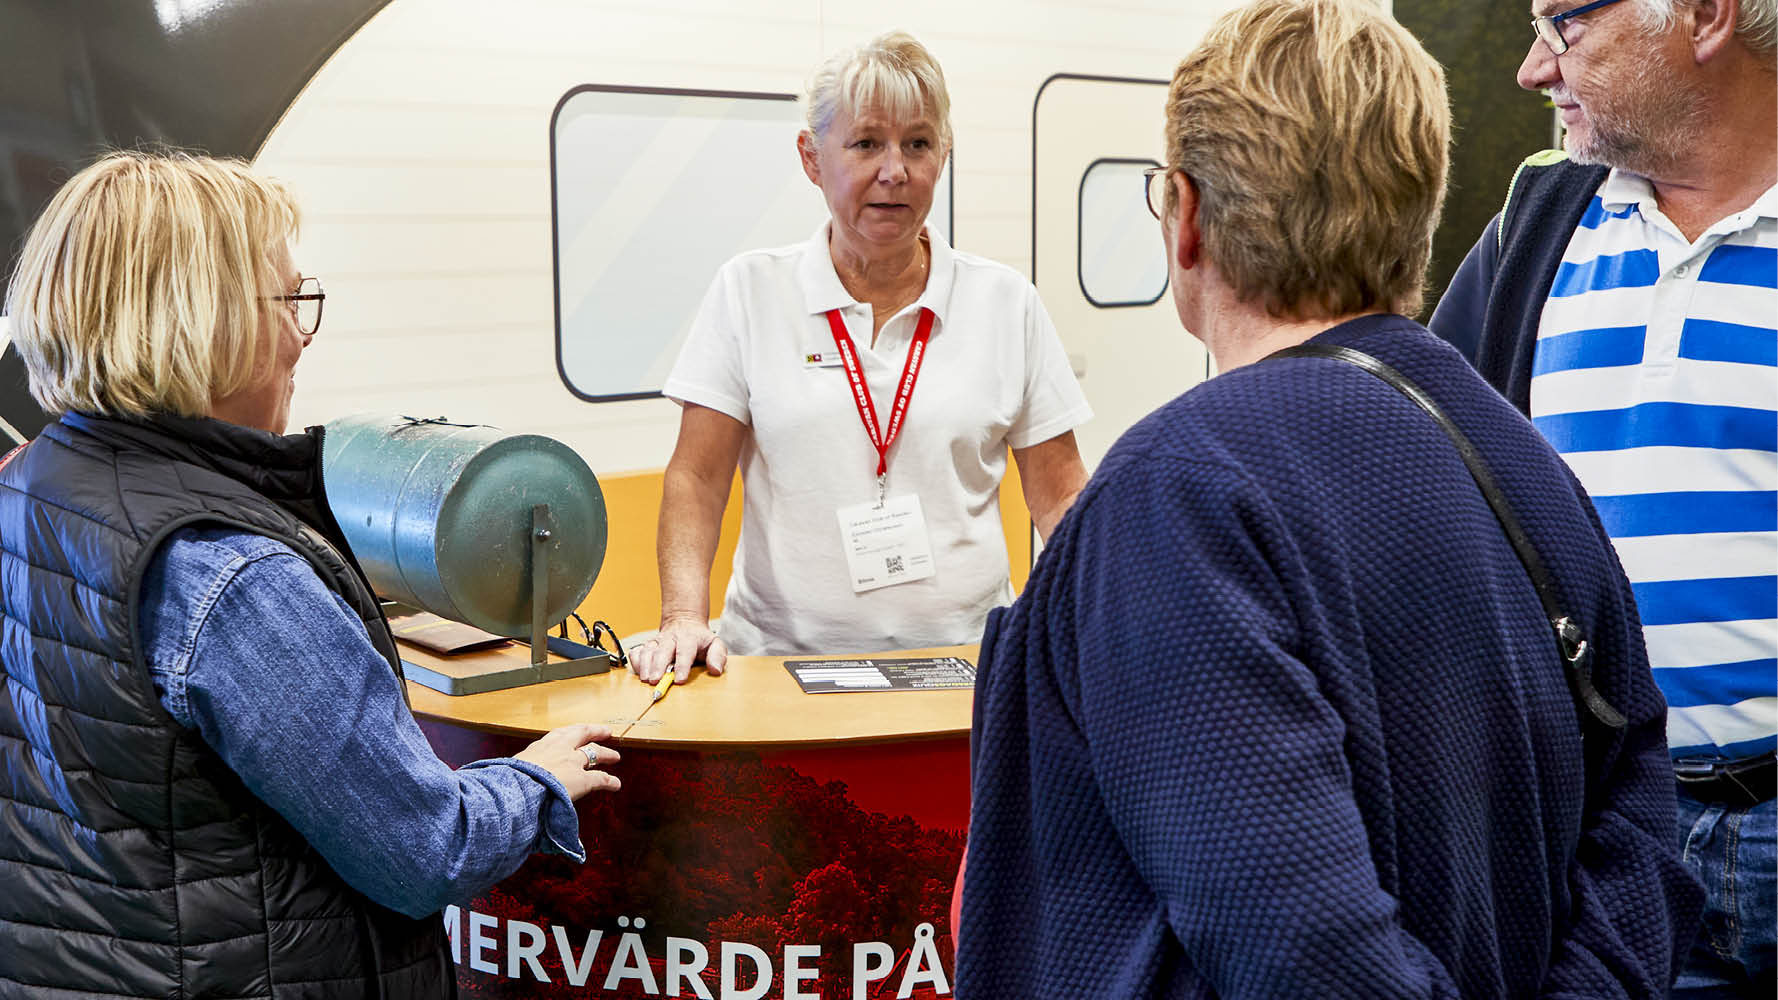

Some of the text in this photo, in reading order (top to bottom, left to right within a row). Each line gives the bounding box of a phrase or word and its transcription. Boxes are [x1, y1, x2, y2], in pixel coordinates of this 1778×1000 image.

[909, 340, 923, 375] CARAVAN
[850, 371, 860, 383] OF
[901, 373, 914, 397] CLUB
[855, 383, 868, 408] CLUB
[897, 396, 906, 410] OF
[853, 922, 951, 1000] PÅ
